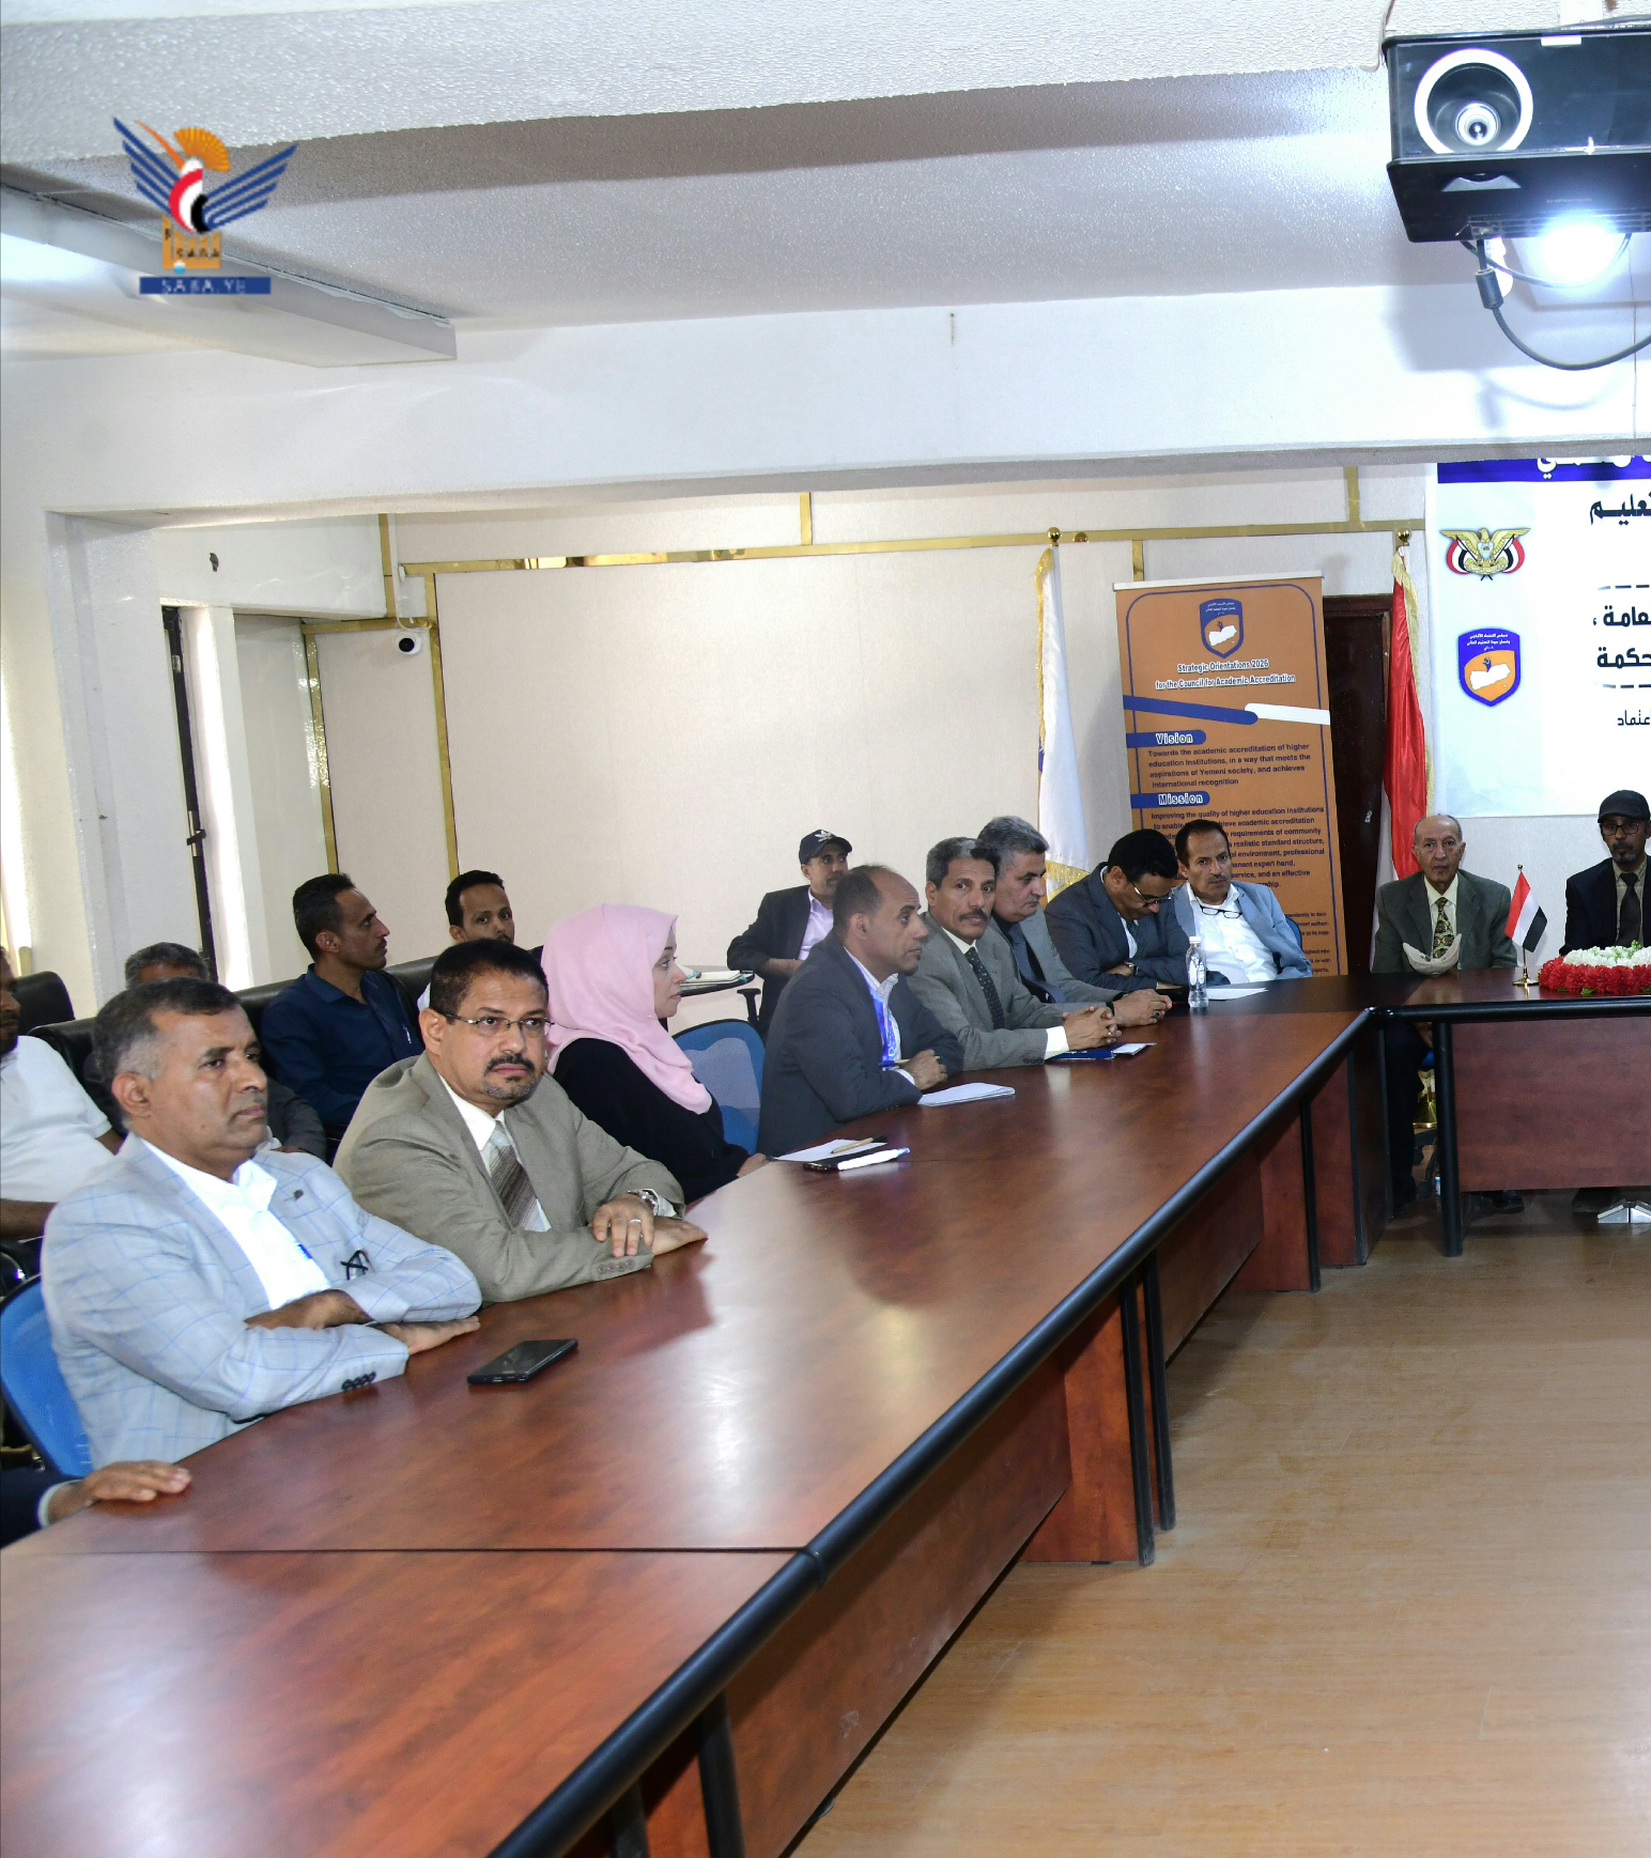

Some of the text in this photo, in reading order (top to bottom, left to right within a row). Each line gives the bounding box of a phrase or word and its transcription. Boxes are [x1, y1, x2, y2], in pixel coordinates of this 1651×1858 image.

[1177, 663, 1208, 674] Strategic
[1210, 661, 1250, 672] Orientations
[1156, 681, 1167, 690] for
[1167, 680, 1178, 689] the
[1179, 678, 1204, 689] Council
[1205, 677, 1215, 688] for
[1216, 675, 1248, 687] Academic
[1155, 732, 1194, 745] Vision
[1180, 748, 1192, 756] the
[1193, 747, 1227, 756] academic
[1229, 744, 1276, 754] accreditation
[1277, 743, 1285, 751] of
[1286, 743, 1310, 752] higher
[1148, 759, 1185, 768] education
[1243, 757, 1258, 765] way
[1259, 755, 1274, 763] that
[1275, 754, 1298, 762] meets
[1299, 753, 1311, 761] the
[1150, 769, 1189, 779] aspirations
[1200, 768, 1226, 776] Yemeni
[1257, 765, 1271, 773] and
[1272, 764, 1305, 772] achieves
[1198, 778, 1239, 788] recognition
[1158, 793, 1204, 806] Mission
[1252, 807, 1286, 816] education
[1238, 818, 1270, 826] academic
[1270, 817, 1315, 826] accreditation
[1283, 827, 1322, 837] community
